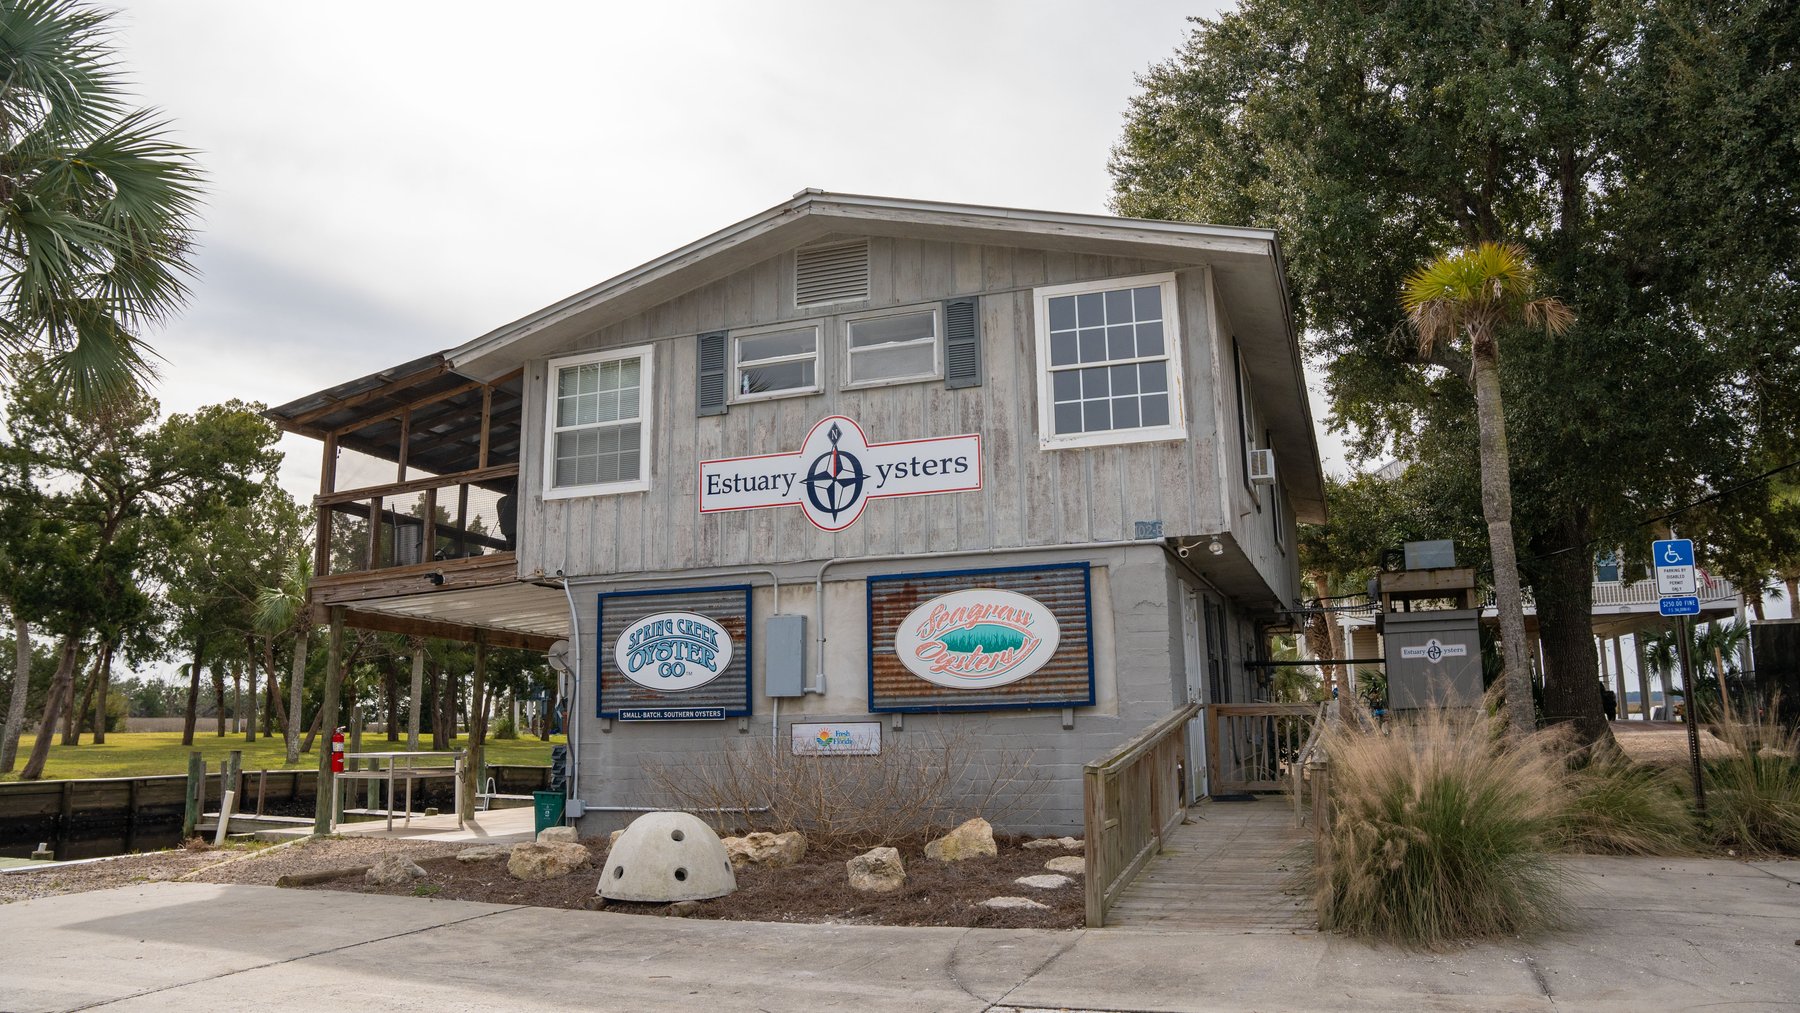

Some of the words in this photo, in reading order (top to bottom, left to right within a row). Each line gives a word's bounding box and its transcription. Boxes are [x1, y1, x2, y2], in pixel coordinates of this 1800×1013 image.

[830, 428, 839, 440] N
[706, 472, 797, 499] Estuary
[1662, 600, 1683, 608] $250.00
[628, 619, 673, 649] SPRING
[676, 618, 719, 648] CREEK
[915, 603, 1034, 640] Seagrass
[628, 640, 717, 673] OYSTER
[914, 638, 1040, 673] Oysters
[657, 661, 686, 678] CO
[694, 710, 721, 718] OYSTERS
